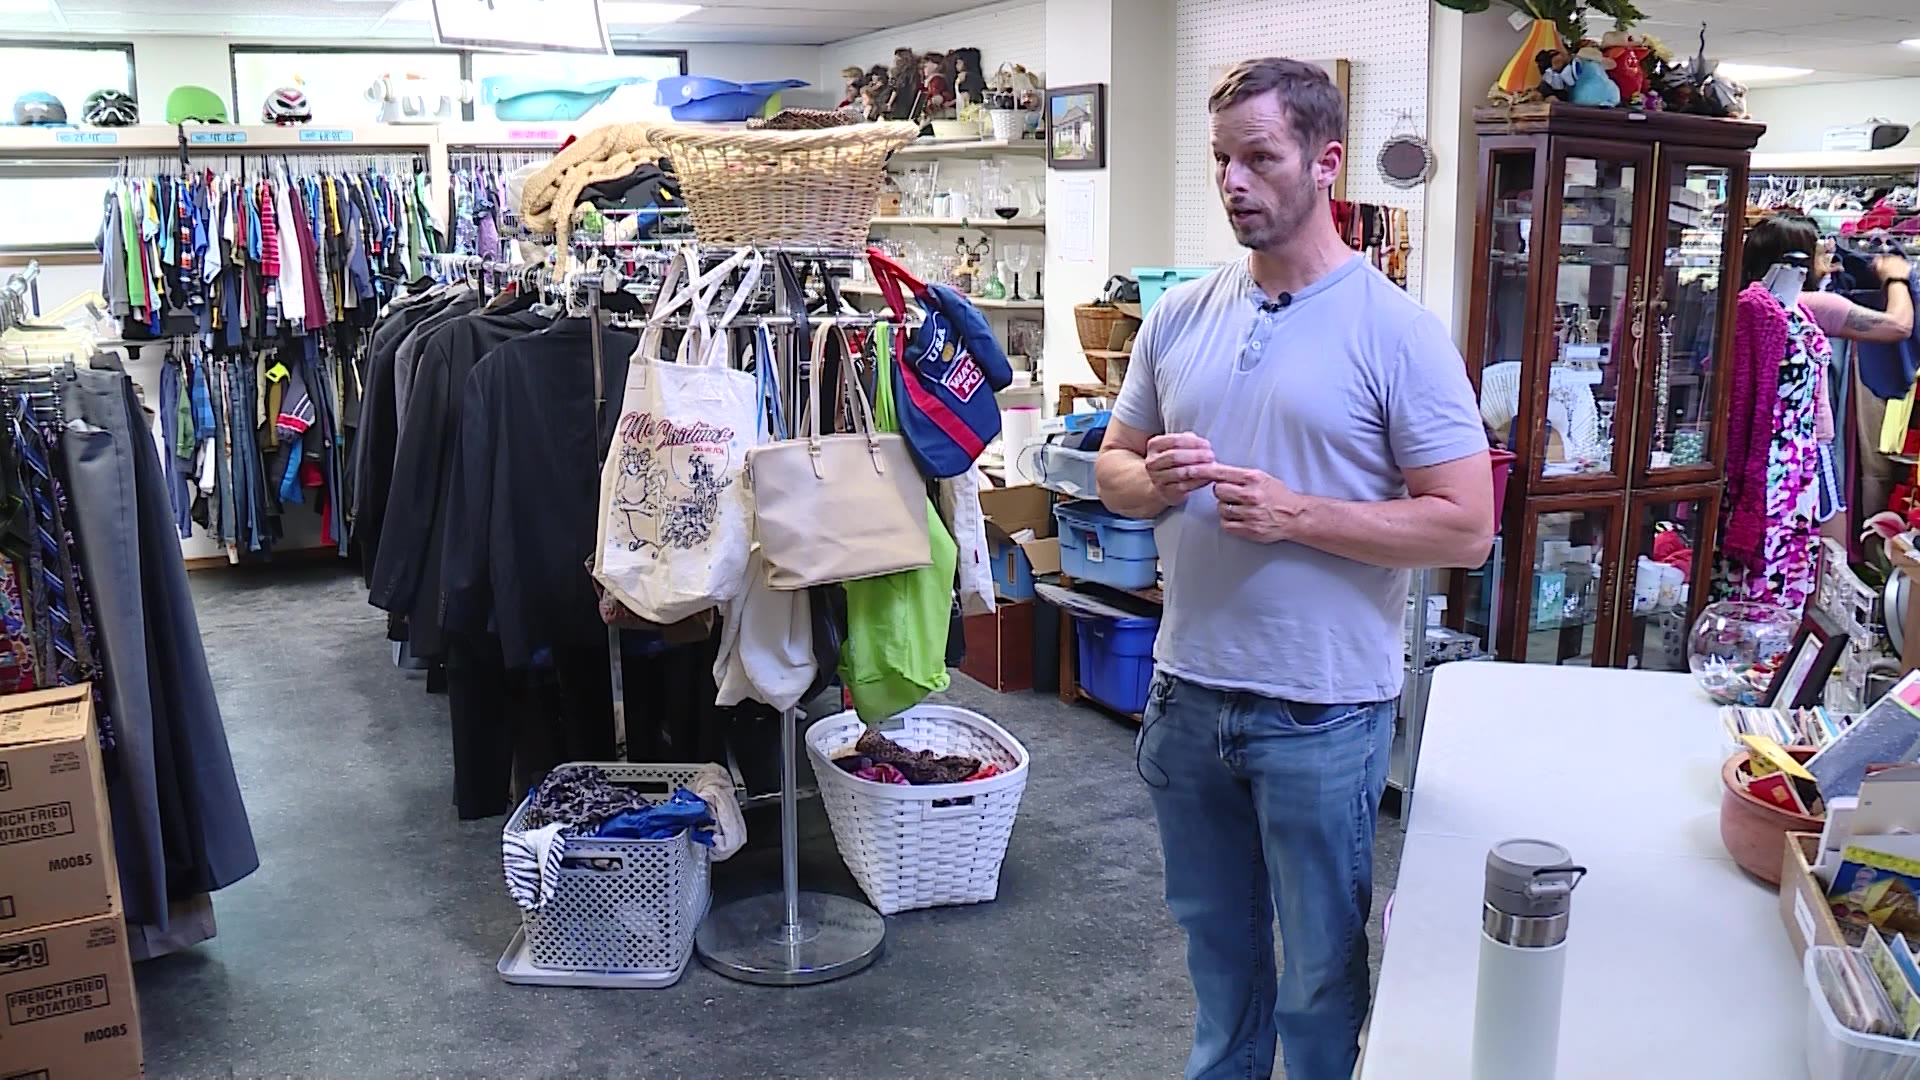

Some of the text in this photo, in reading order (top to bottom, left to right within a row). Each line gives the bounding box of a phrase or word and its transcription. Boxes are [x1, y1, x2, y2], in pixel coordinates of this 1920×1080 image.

[926, 328, 946, 362] USA
[30, 806, 68, 822] FRIED
[0, 821, 57, 841] OTATOES
[10, 979, 104, 1008] FRENCH FRIED
[26, 994, 93, 1018] POTATOES
